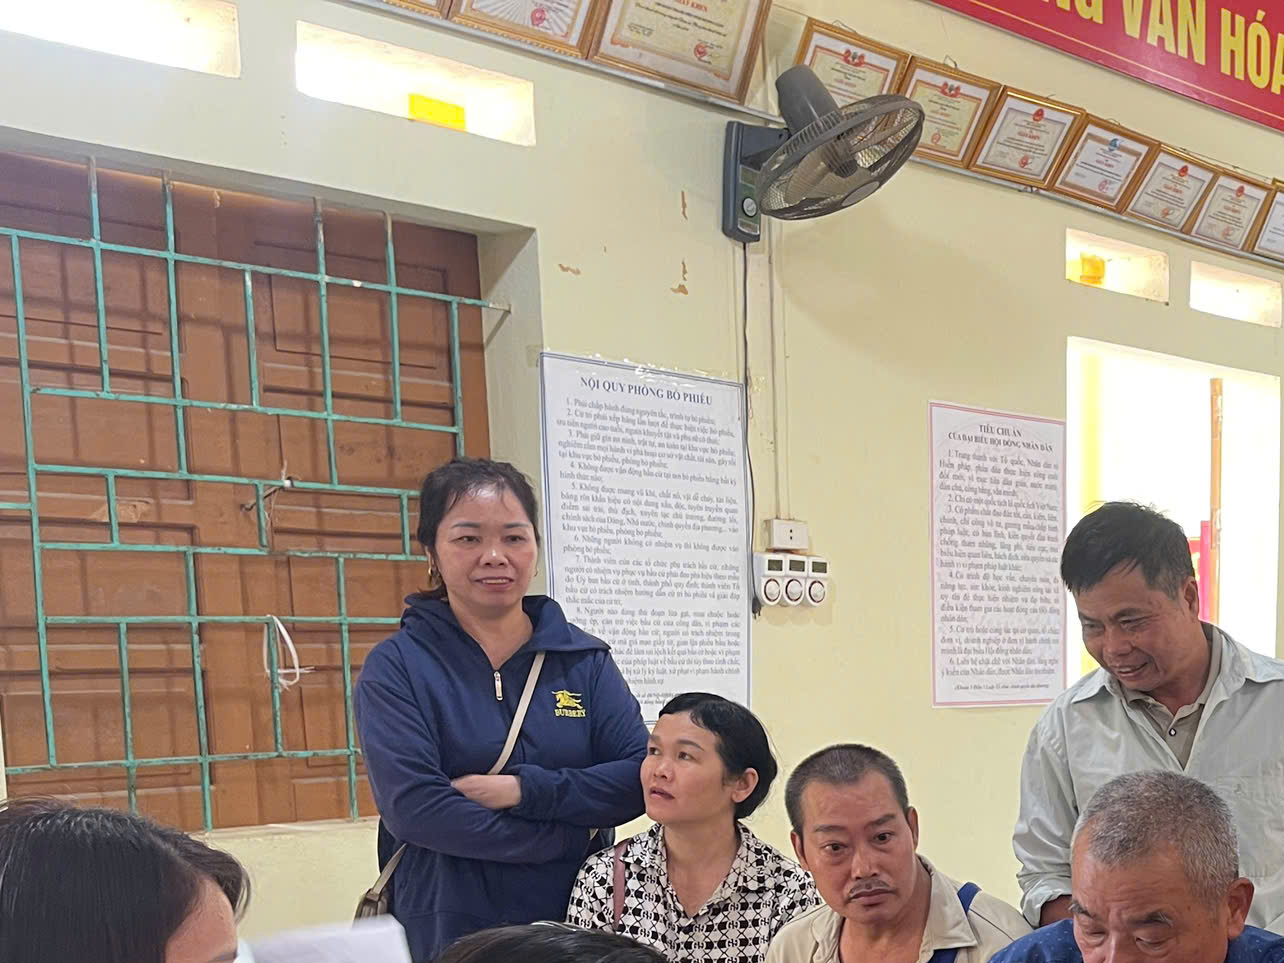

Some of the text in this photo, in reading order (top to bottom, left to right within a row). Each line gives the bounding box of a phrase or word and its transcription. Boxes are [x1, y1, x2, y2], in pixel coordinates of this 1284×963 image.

[580, 375, 599, 391] NỘI
[602, 380, 625, 394] QUY
[627, 381, 663, 398] PHÒNG
[683, 389, 712, 405] PHIẾU
